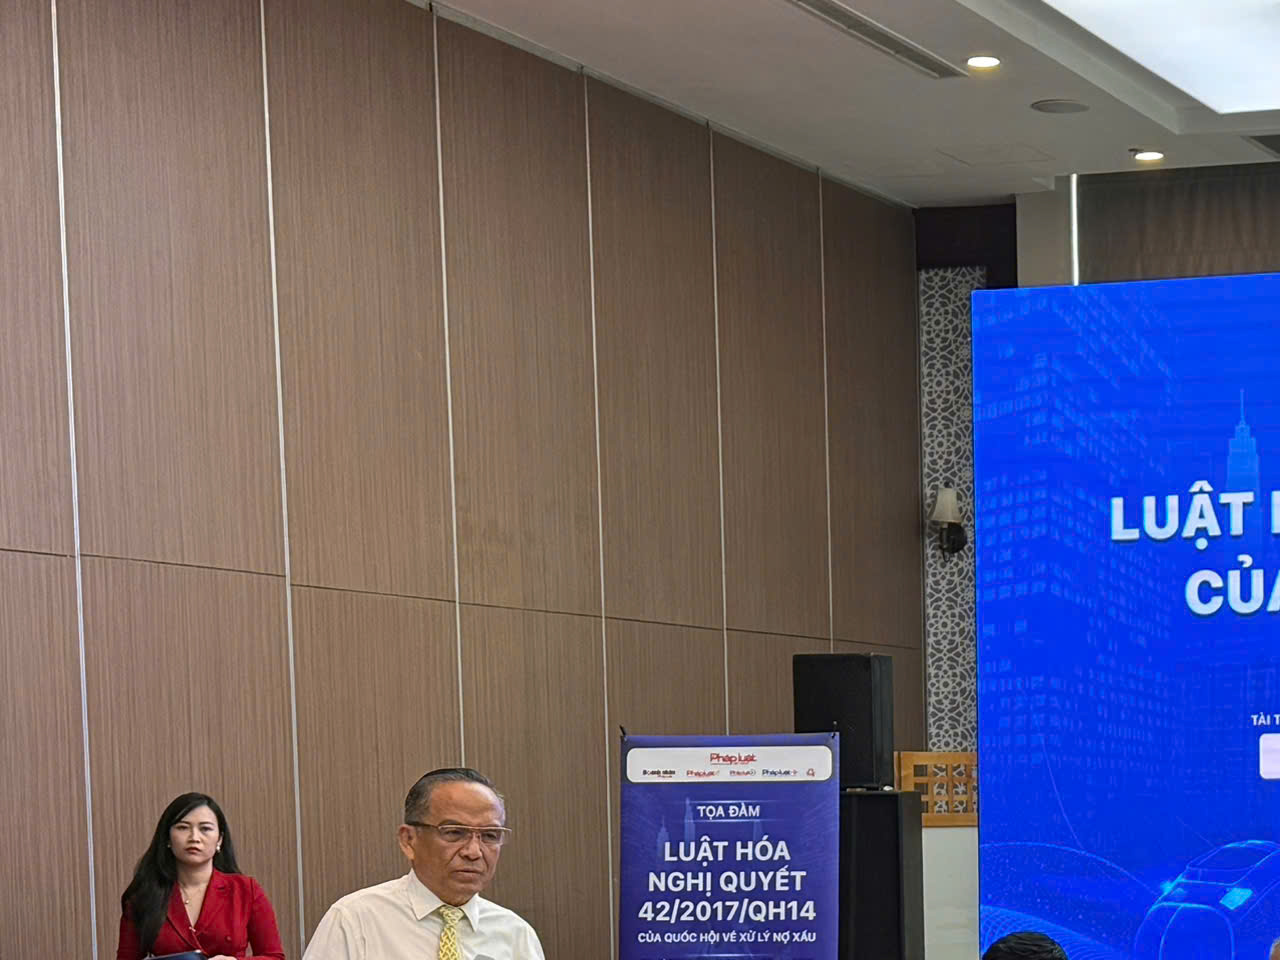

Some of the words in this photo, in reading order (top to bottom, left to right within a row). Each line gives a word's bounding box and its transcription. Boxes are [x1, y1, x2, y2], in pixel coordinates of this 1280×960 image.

[1110, 481, 1254, 550] LUẬT
[1250, 711, 1273, 727] TÀI
[710, 752, 737, 765] Pháp
[697, 805, 725, 821] TỌA
[729, 802, 761, 818] ĐÀM
[664, 835, 729, 867] LUẬT
[736, 835, 791, 862] HÓA
[648, 871, 712, 897] NGHỊ
[719, 865, 807, 893] QUYẾT
[638, 898, 816, 923] 42/2017/QH14
[638, 930, 662, 943] CỦA
[664, 930, 697, 944] QUỐC
[700, 930, 720, 945] HỘI
[722, 930, 737, 943] VỀ
[739, 930, 757, 943] XỬ
[758, 930, 771, 943] LÝ
[773, 930, 790, 945] NỢ
[792, 929, 816, 943] XẤU
